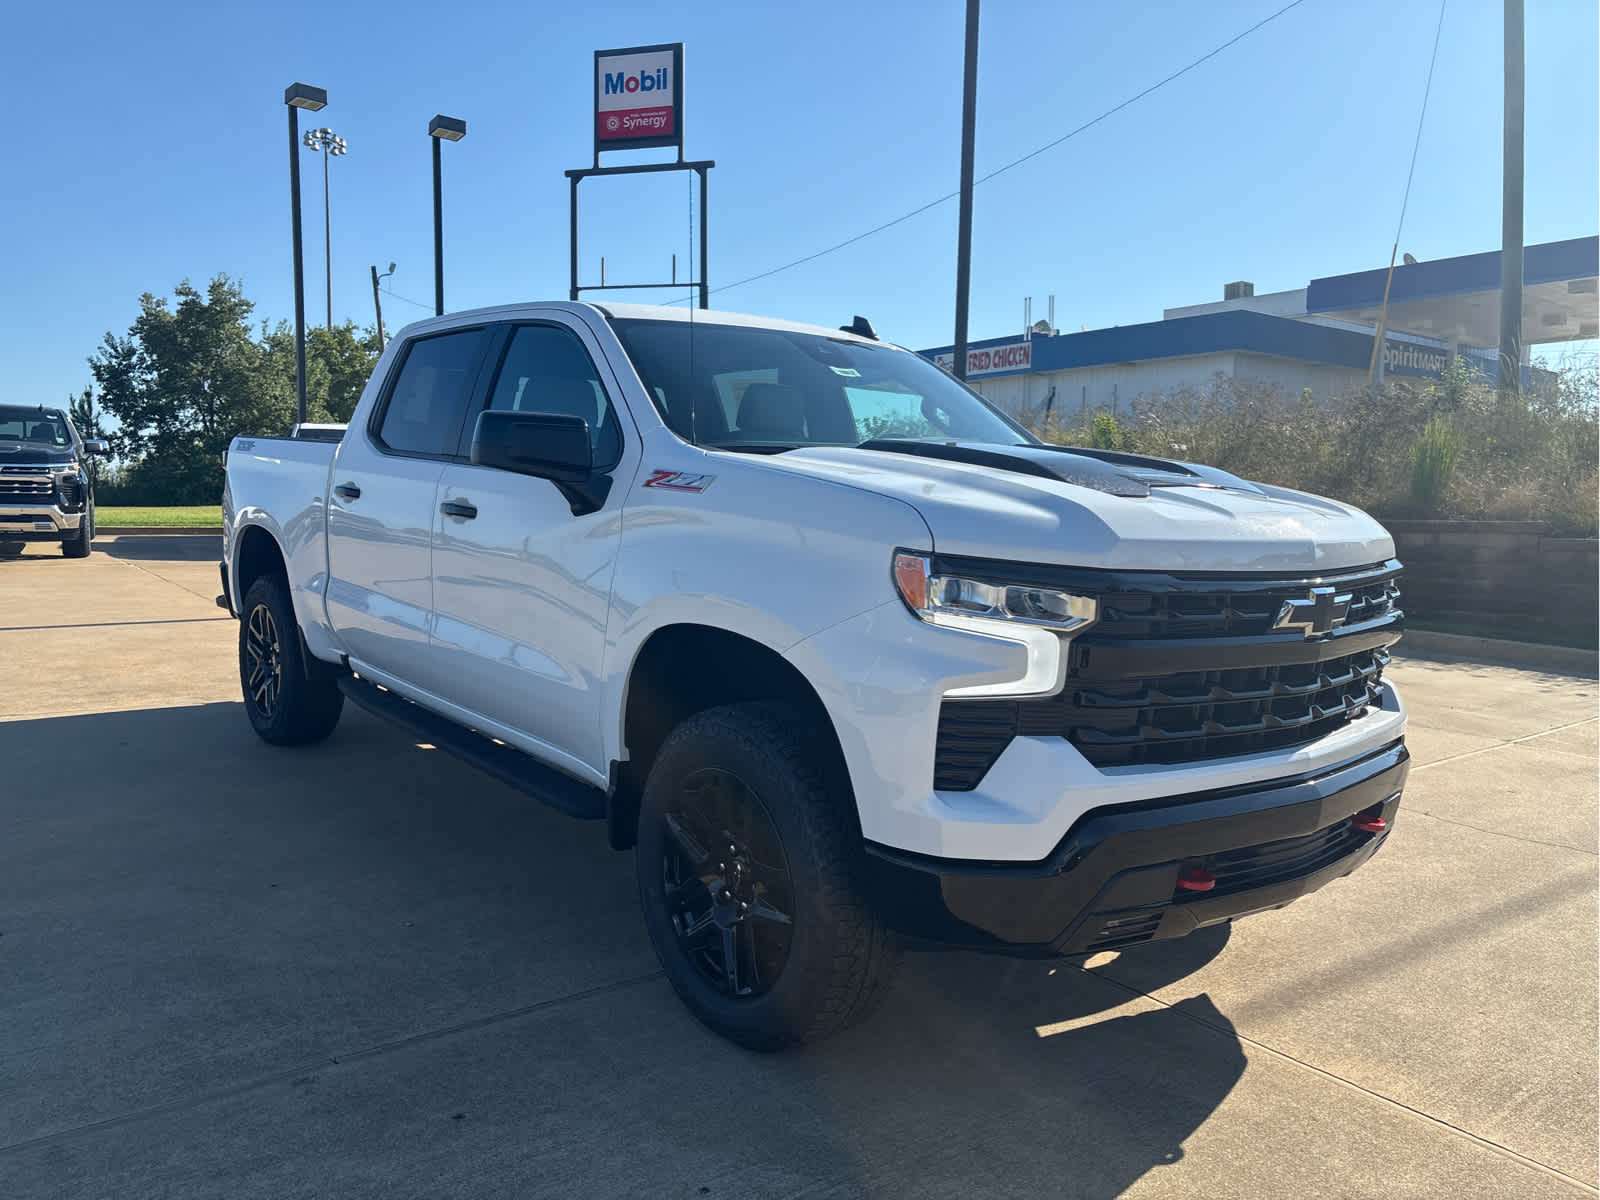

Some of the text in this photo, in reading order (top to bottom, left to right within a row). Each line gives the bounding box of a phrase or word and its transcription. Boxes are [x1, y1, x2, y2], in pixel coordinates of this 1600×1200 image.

[605, 67, 667, 95] Mobil
[623, 115, 666, 130] Synergy
[968, 351, 991, 372] FRIED
[992, 345, 1030, 369] CHICKEN
